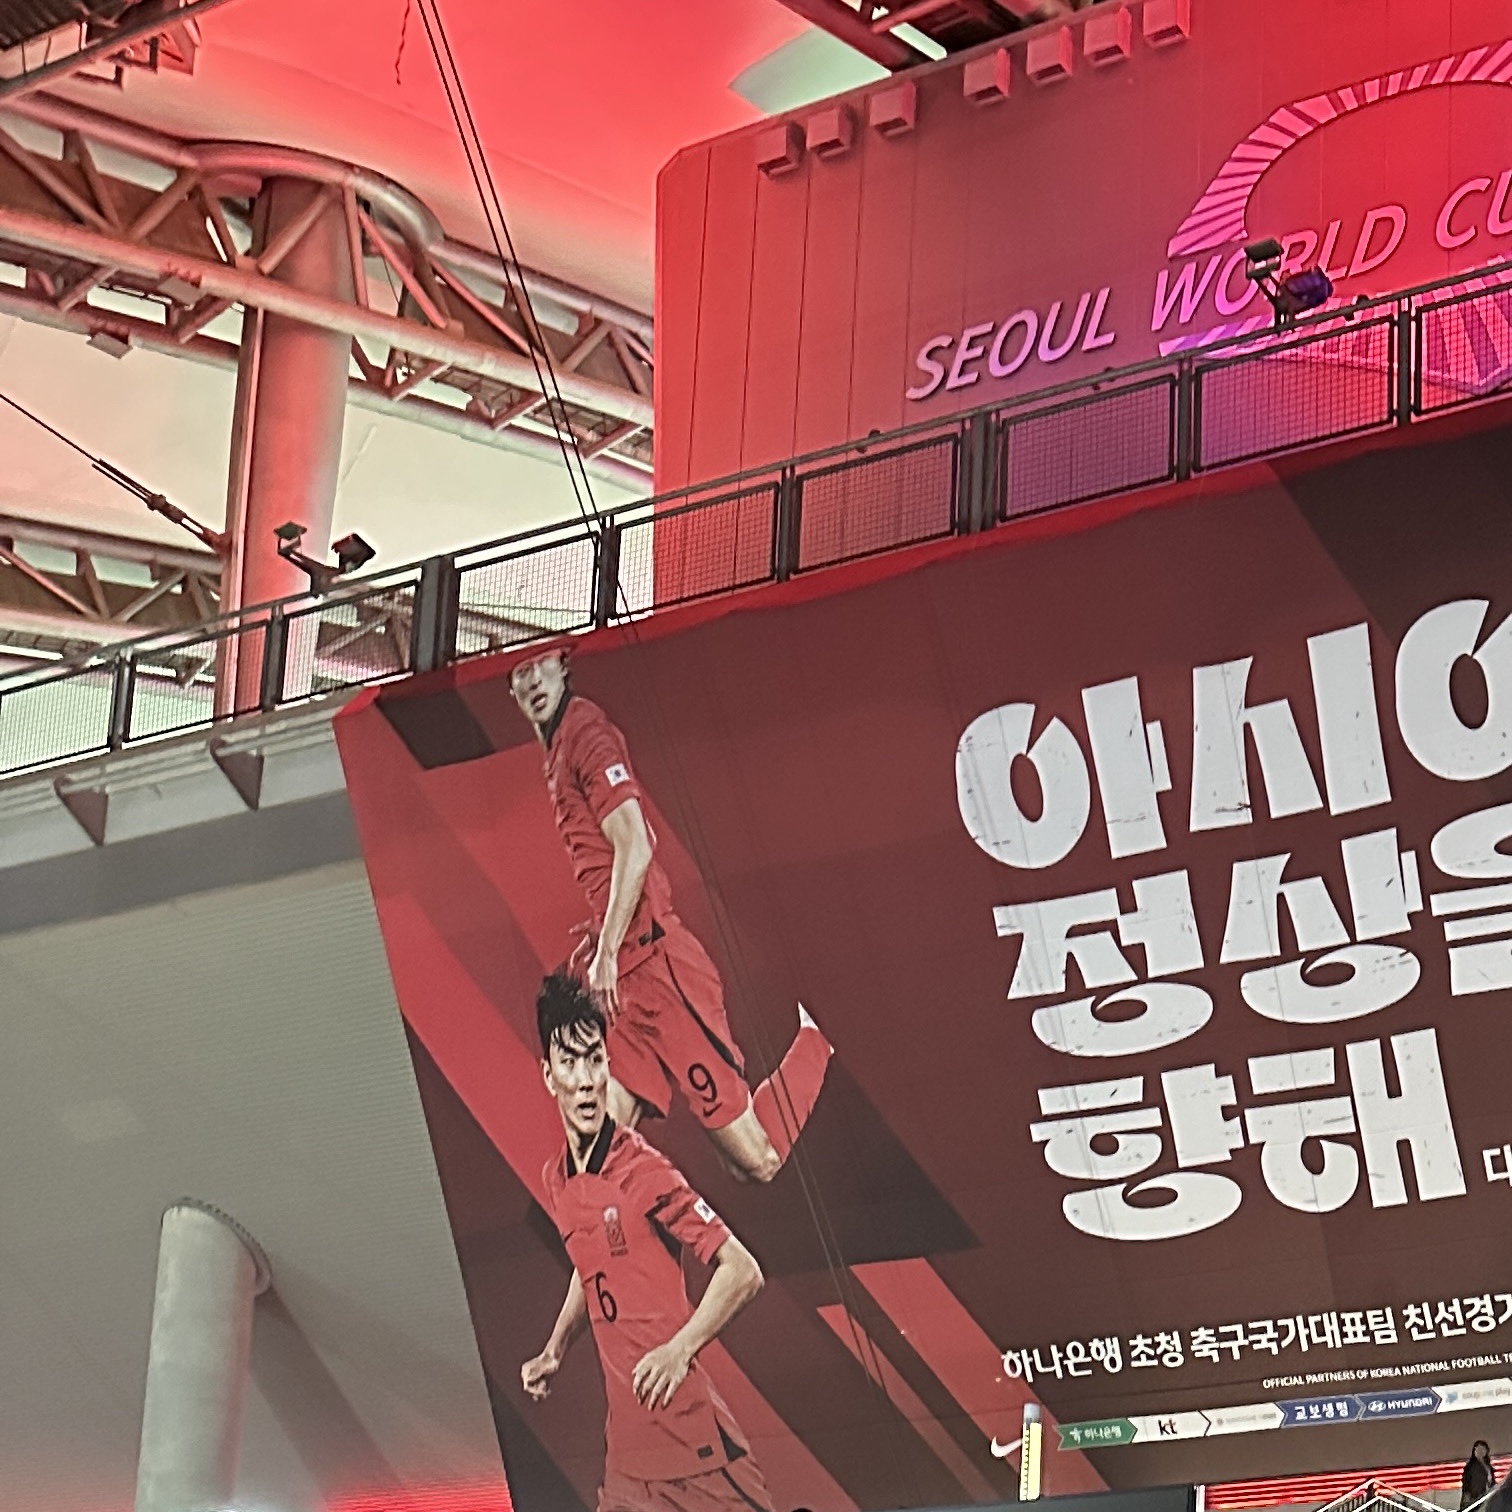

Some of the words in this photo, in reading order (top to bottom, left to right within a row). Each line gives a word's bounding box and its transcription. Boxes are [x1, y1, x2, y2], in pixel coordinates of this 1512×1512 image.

[906, 287, 1115, 400] SEOUL
[1150, 204, 1408, 333] WORLD
[1029, 1027, 1468, 1242] 향해
[595, 1271, 618, 1323] 6
[1001, 1336, 1123, 1383] 하나은행
[1129, 1331, 1184, 1370] 초청
[1190, 1305, 1397, 1364] 축구국가대표팀
[1263, 1375, 1305, 1389] OFFICIAL
[1305, 1370, 1355, 1386] PARTNERS
[1356, 1369, 1369, 1380] OF
[1370, 1366, 1401, 1379] KOREA
[1402, 1361, 1451, 1376] NATIONAL
[1451, 1354, 1502, 1370] FOOTBALL
[1158, 1419, 1177, 1436] kt
[1295, 1401, 1349, 1421] 교보생명
